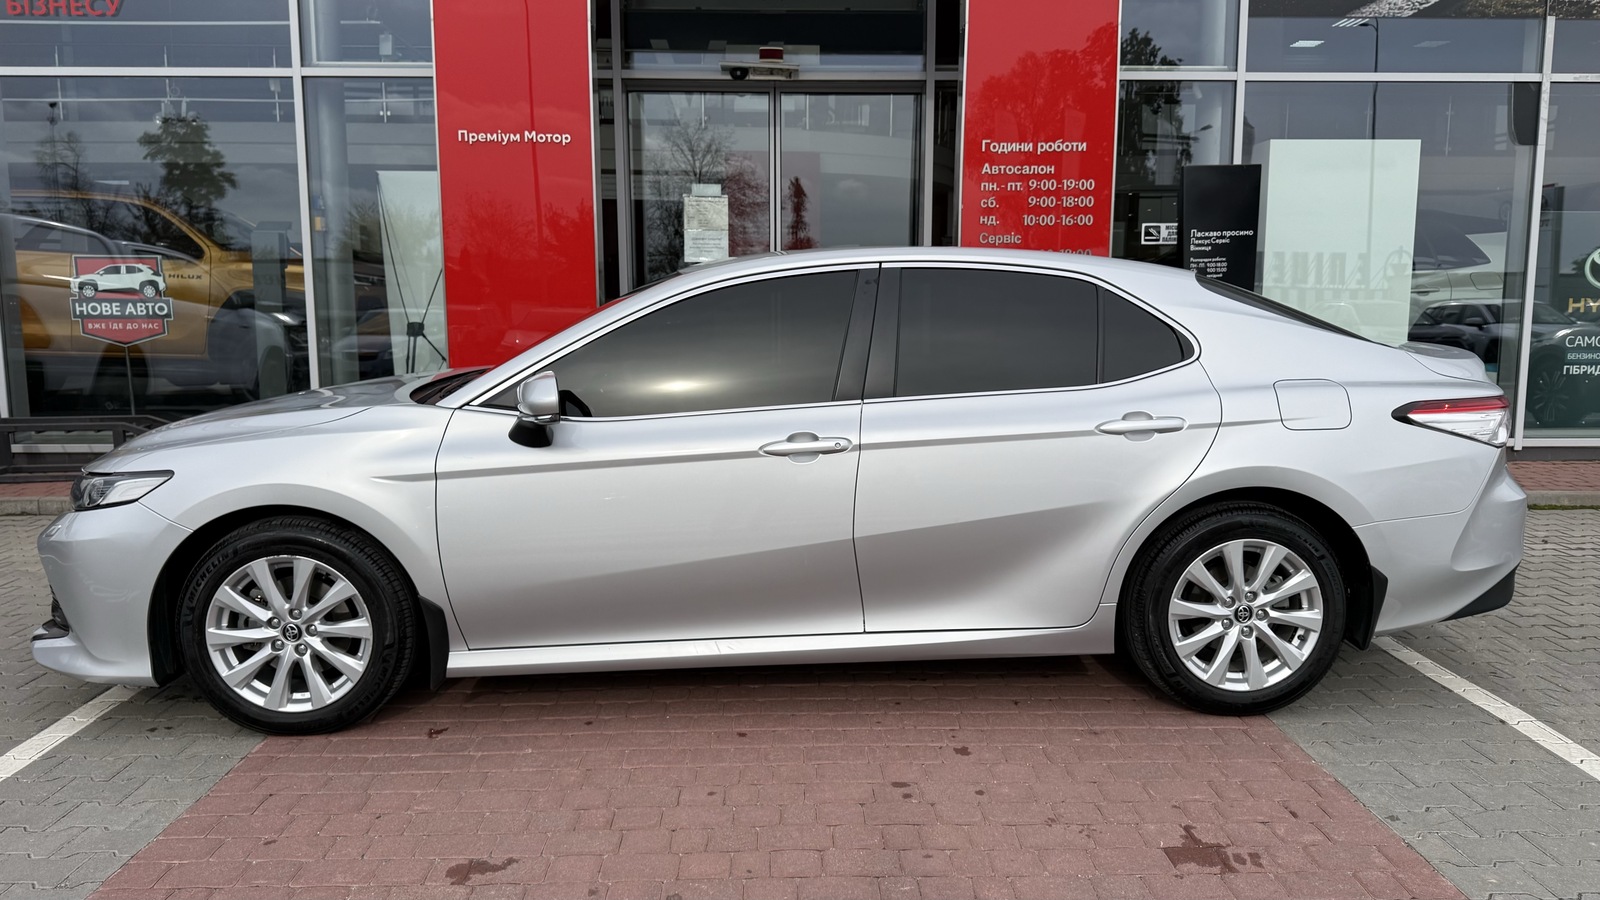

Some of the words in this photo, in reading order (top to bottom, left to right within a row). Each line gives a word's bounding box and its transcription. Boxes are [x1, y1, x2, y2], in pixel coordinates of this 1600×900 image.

[457, 129, 521, 145] Преміум
[524, 130, 571, 146] Мотор
[981, 139, 1033, 155] Години
[1037, 139, 1087, 155] роботи
[981, 162, 1055, 176] Автосалон
[1028, 179, 1095, 191] 9:00-19:00
[980, 196, 1000, 208] сб.
[1028, 195, 1094, 208] 9:00-18:00
[979, 215, 1000, 226] нд.
[1022, 214, 1094, 226] 10:00-16:00
[979, 232, 1022, 247] Сервіс
[1190, 229, 1221, 238] Ласкаво
[1222, 230, 1254, 238] просимо
[75, 302, 120, 315] НОВЕ
[125, 302, 168, 315] АВТО
[188, 552, 230, 603] MICHELIN
